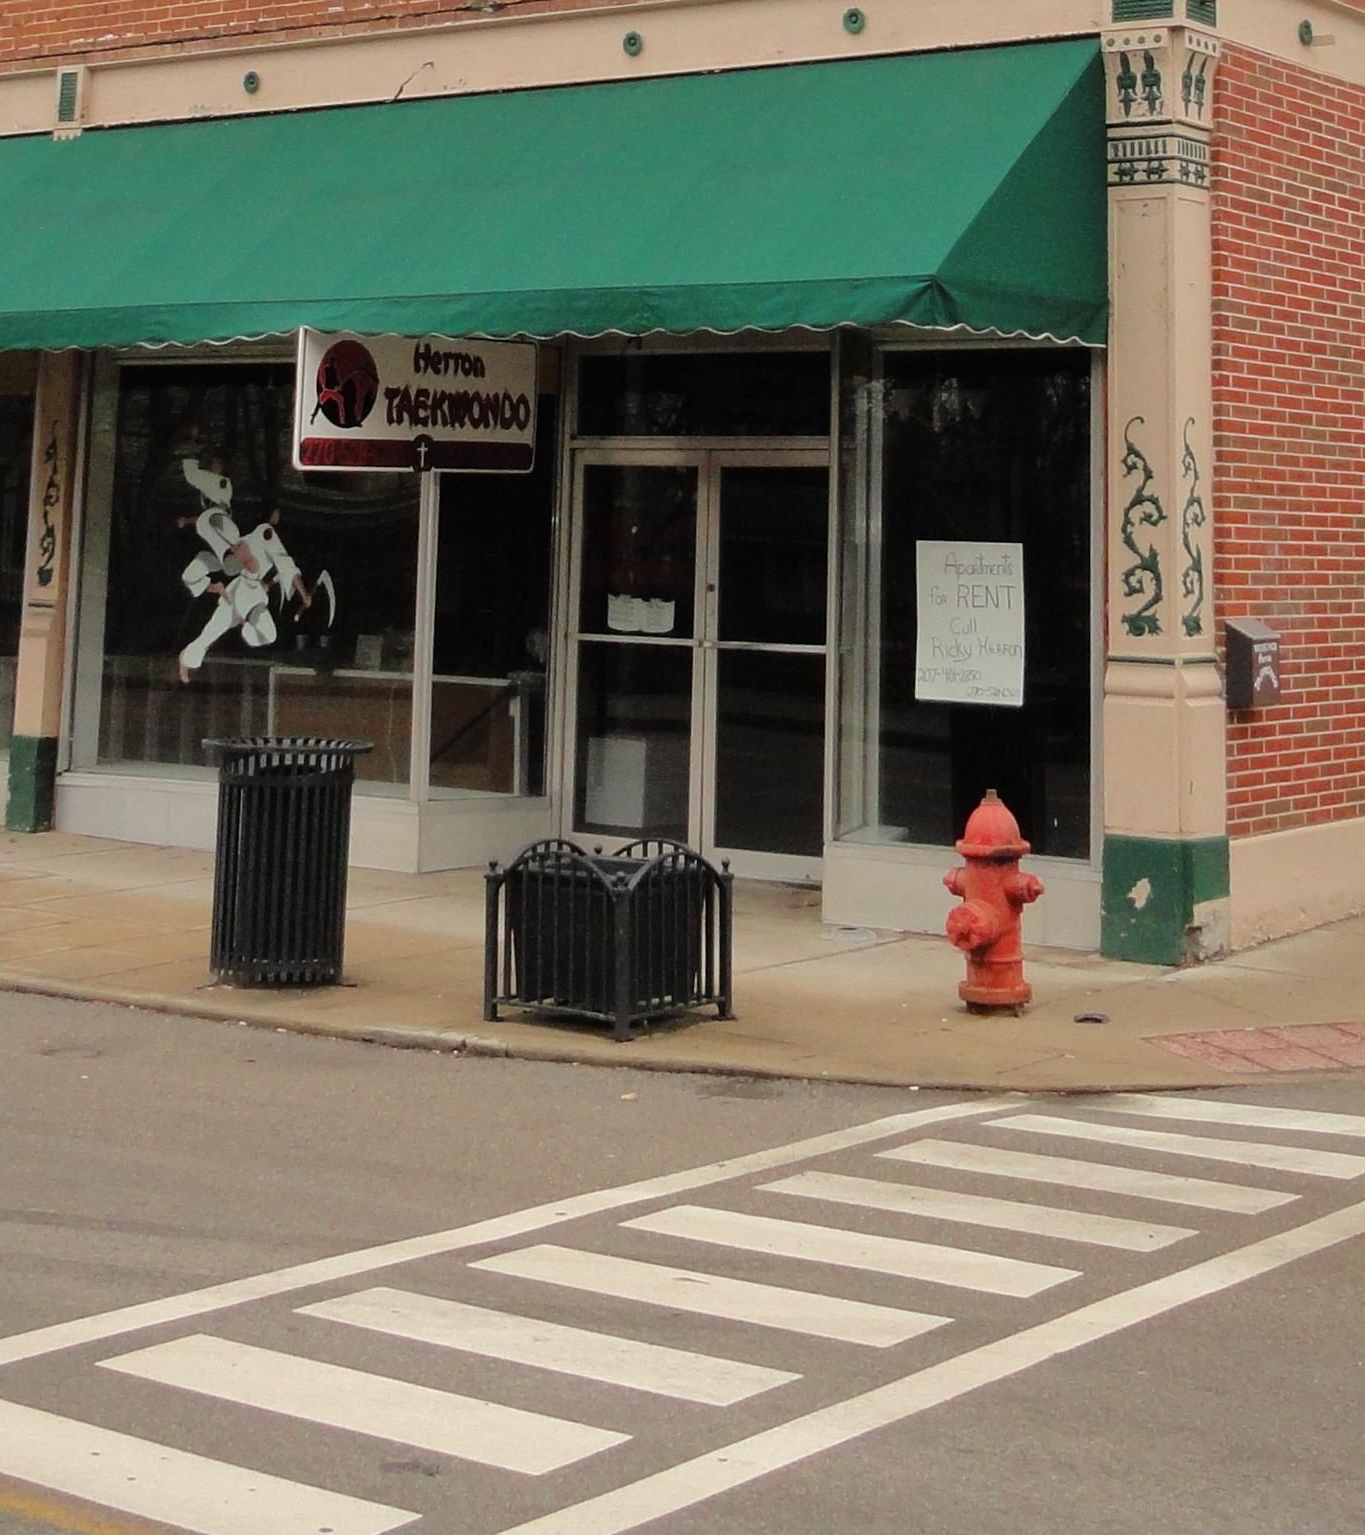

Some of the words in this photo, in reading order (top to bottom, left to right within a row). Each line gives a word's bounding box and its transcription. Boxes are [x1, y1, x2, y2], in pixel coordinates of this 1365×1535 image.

[413, 343, 485, 378] Herron
[384, 384, 531, 431] TAEKWONDO
[956, 584, 1017, 610] RENT
[949, 617, 978, 635] Call
[931, 637, 973, 663] Ricky
